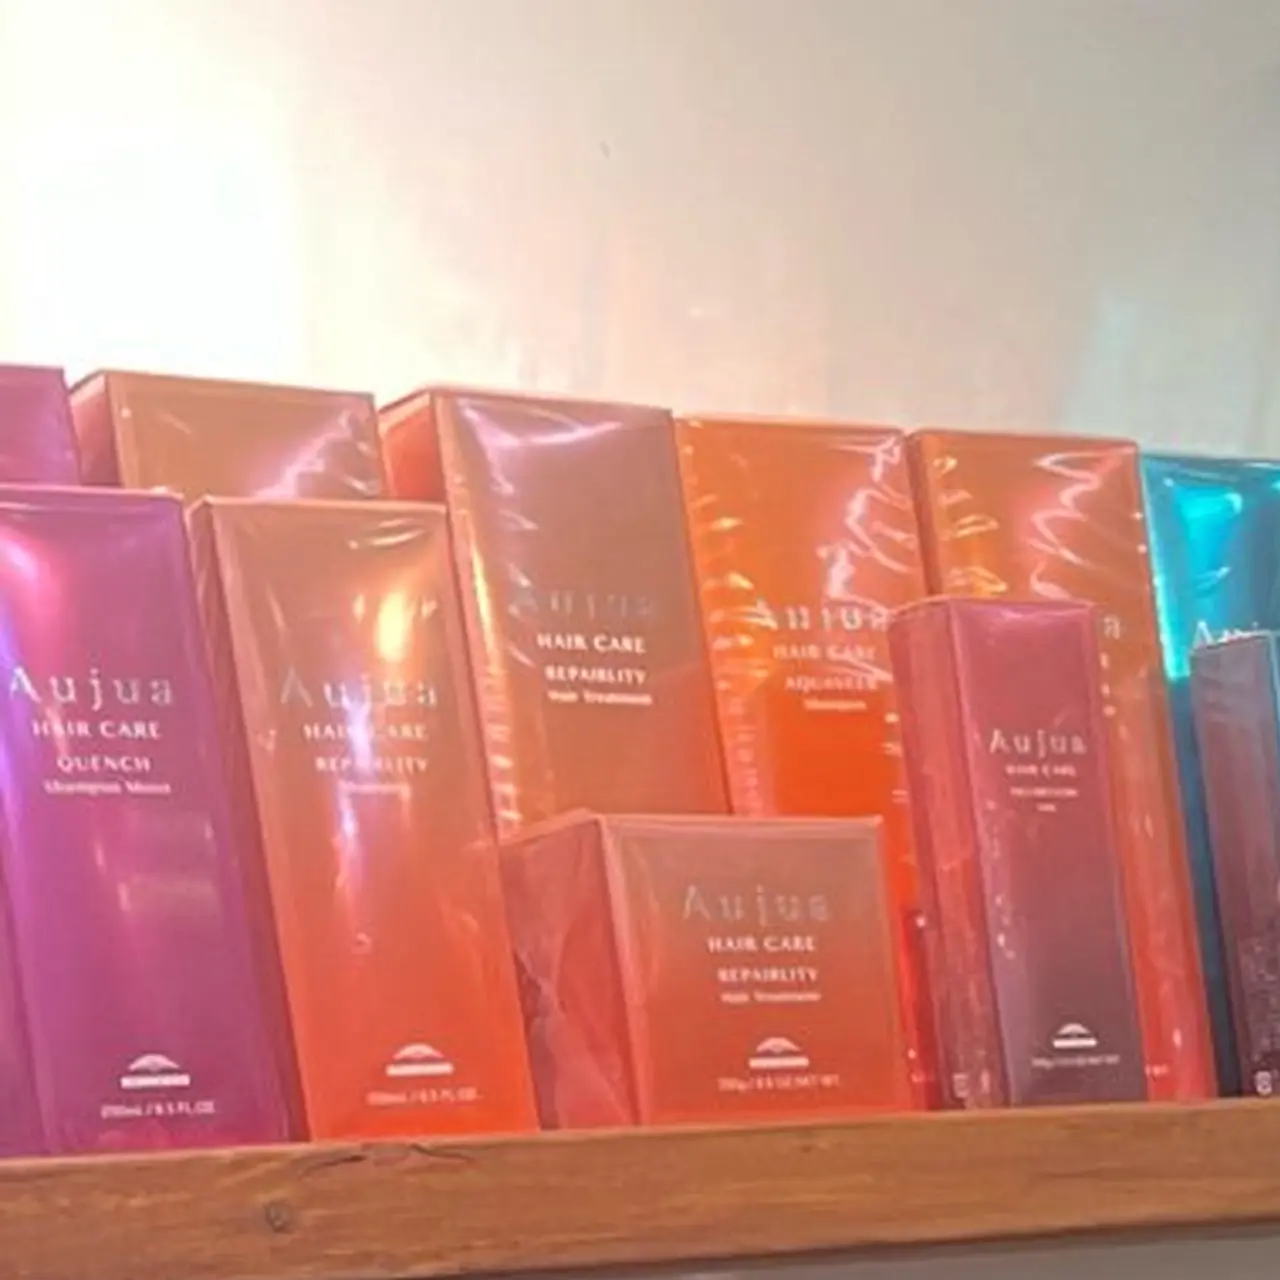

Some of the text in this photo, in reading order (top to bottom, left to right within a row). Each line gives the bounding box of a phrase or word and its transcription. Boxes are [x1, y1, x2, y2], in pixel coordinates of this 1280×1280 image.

[536, 633, 646, 653] HAIR CARE
[8, 665, 172, 711] Aujua
[99, 720, 162, 740] CARE
[707, 934, 816, 953] HAIR CARE
